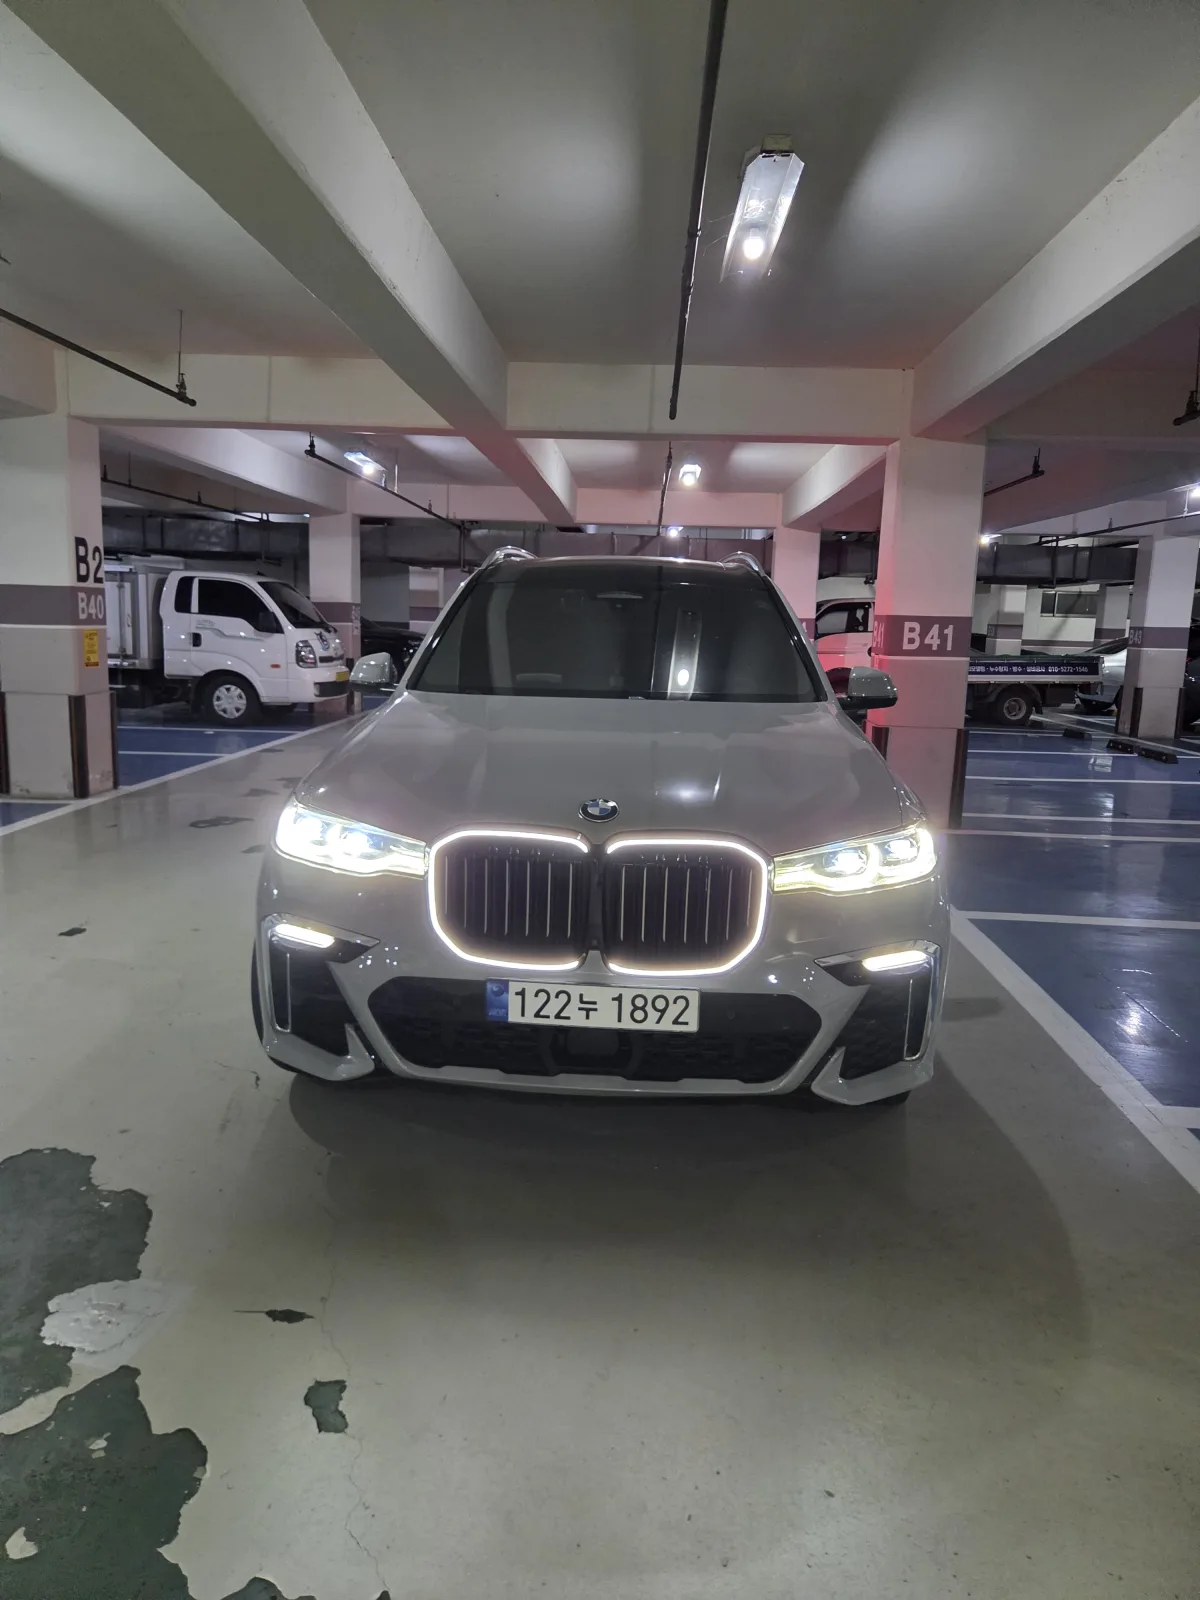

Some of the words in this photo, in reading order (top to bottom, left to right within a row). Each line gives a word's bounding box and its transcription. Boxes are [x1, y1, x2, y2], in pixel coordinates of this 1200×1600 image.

[75, 537, 104, 584] B2
[78, 592, 104, 619] B40
[902, 621, 954, 651] B41
[1128, 629, 1143, 645] B43
[514, 987, 598, 1020] 122누
[611, 993, 690, 1026] 1892
